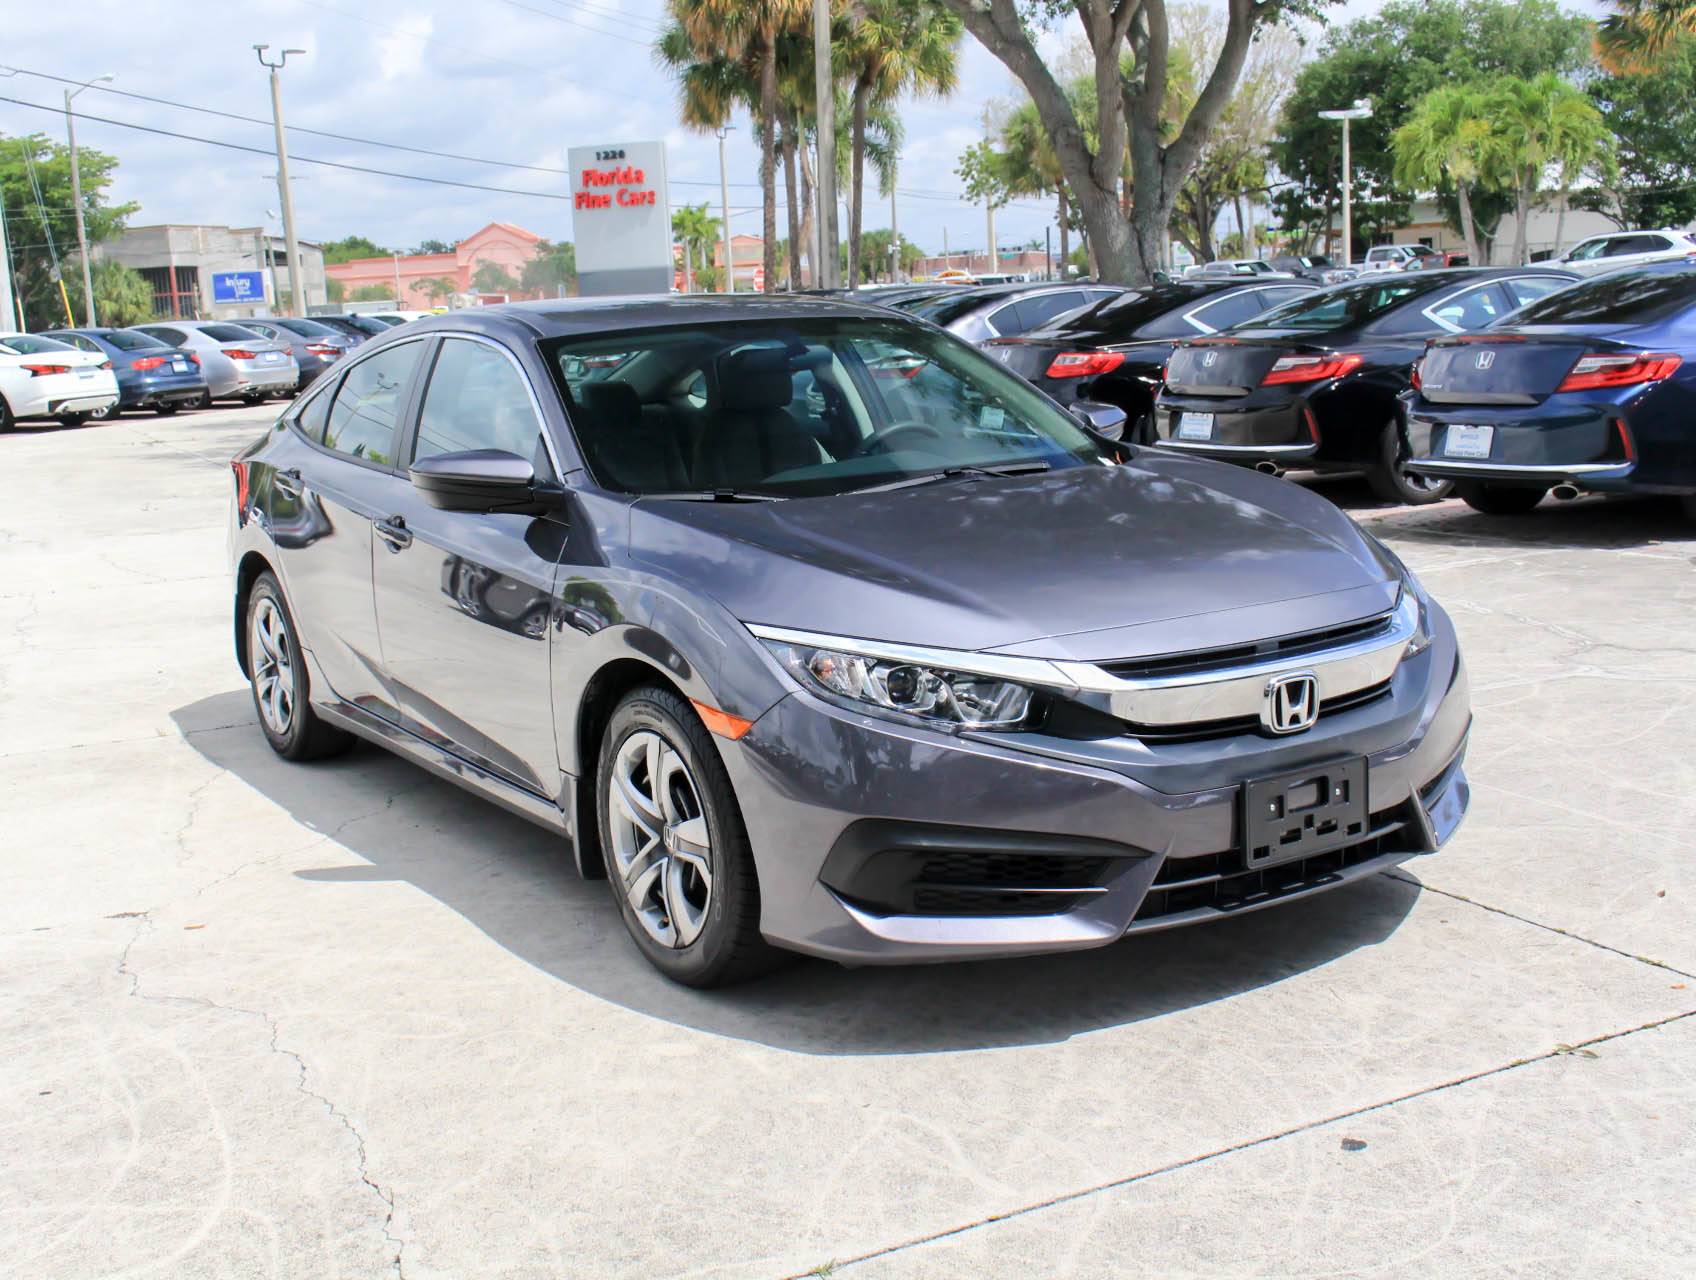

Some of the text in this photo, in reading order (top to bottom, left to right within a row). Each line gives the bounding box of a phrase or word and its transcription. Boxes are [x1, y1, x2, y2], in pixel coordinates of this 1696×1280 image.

[582, 165, 645, 188] Florida
[574, 188, 656, 209] Fine Cars
